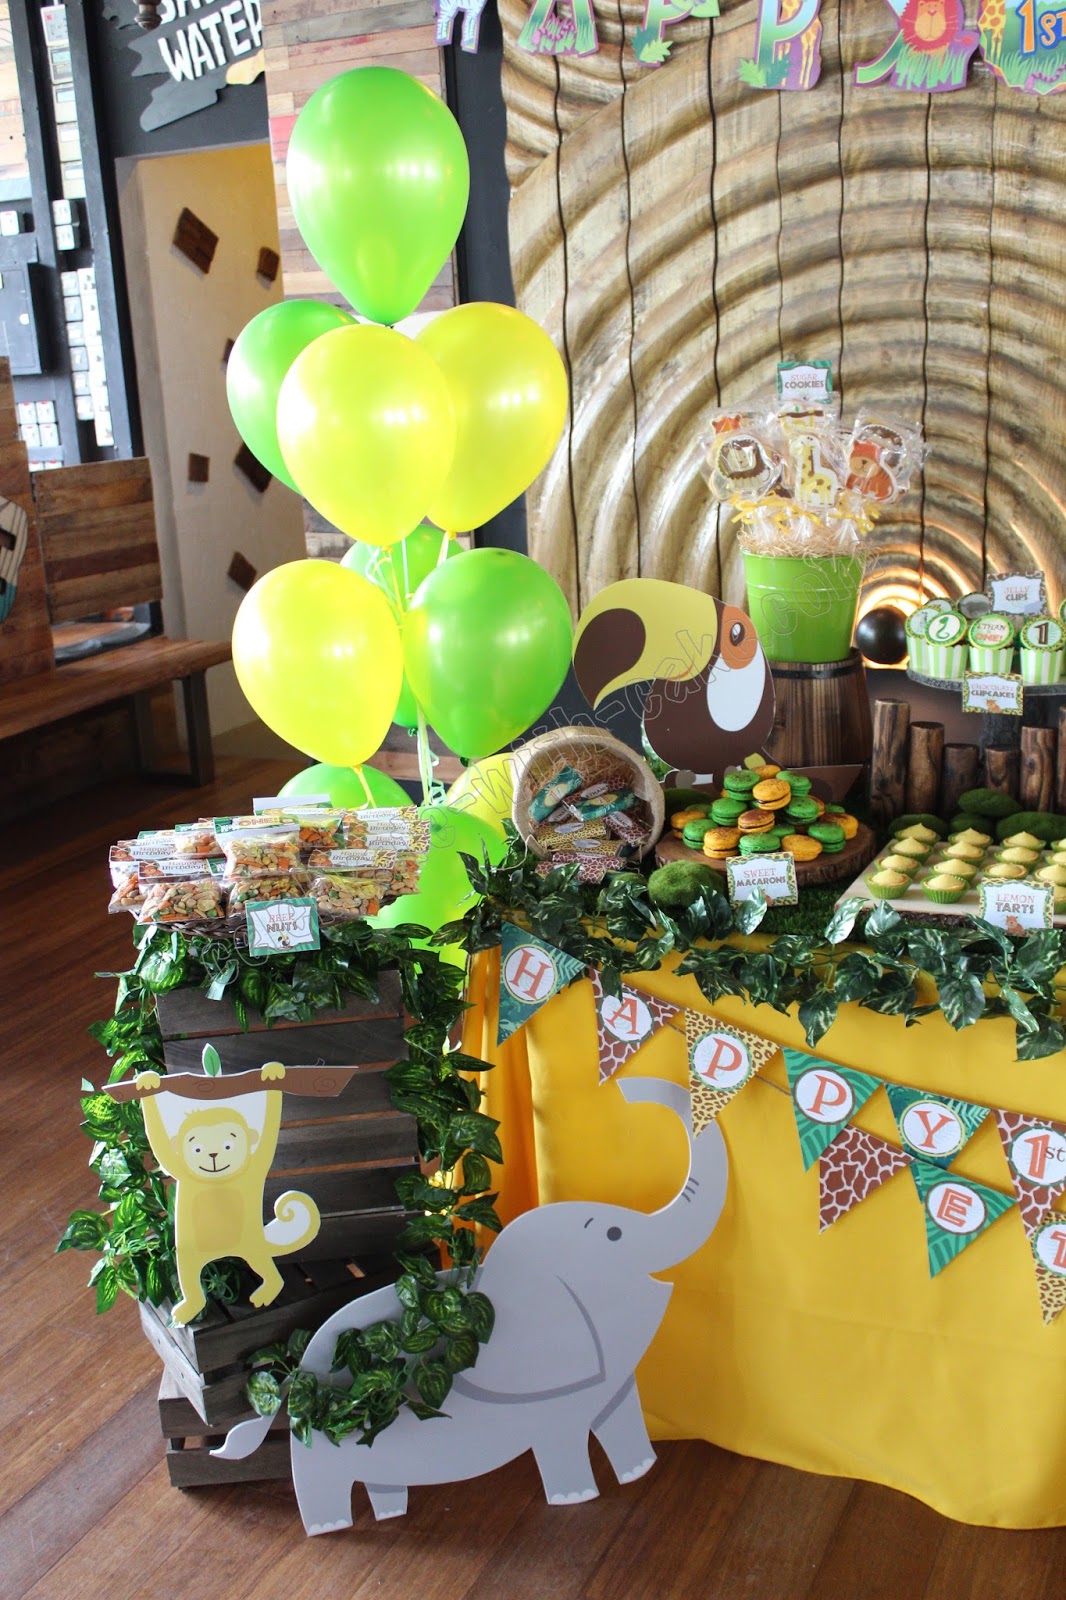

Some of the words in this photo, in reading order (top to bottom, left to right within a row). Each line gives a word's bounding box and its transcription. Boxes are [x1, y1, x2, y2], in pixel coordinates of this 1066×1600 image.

[784, 380, 825, 389] COOKIES
[1005, 586, 1030, 594] JELLY
[1005, 593, 1028, 601] CUPS
[1033, 622, 1049, 645] 1
[971, 683, 1015, 692] CHOCOLATE
[970, 690, 1015, 699] CUPCAKES
[743, 867, 777, 879] SWEET
[736, 875, 787, 888] MACARONS
[996, 893, 1035, 904] LEMON
[995, 901, 1035, 915] TARTS
[266, 921, 298, 933] NUTS
[508, 948, 957, 1151] HAPPY
[1023, 1133, 1066, 1180] 1st
